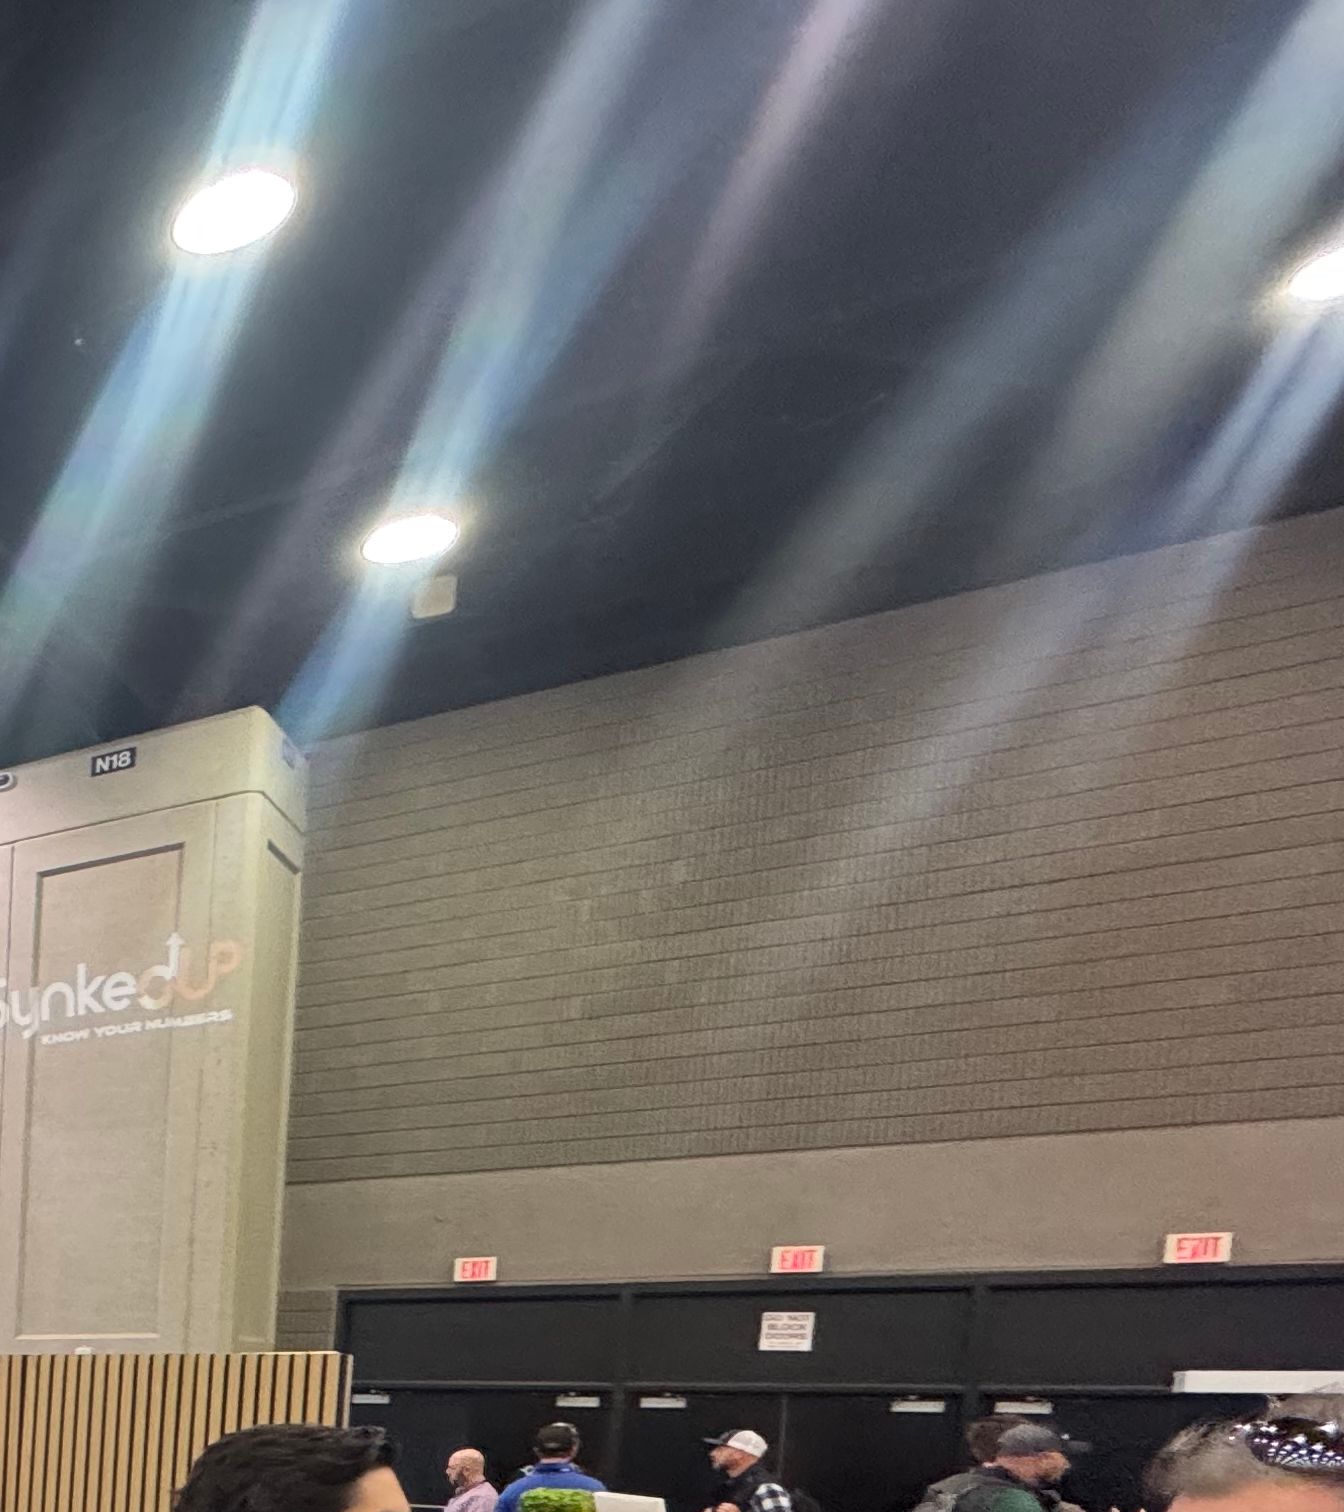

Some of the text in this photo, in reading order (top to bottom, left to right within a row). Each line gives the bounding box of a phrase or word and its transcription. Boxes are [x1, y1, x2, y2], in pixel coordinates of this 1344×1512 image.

[95, 751, 131, 773] N18
[41, 1009, 234, 1045] KNOW YOUR NUMBERS
[461, 1260, 490, 1279] EXIT
[780, 1251, 818, 1271] EXIT
